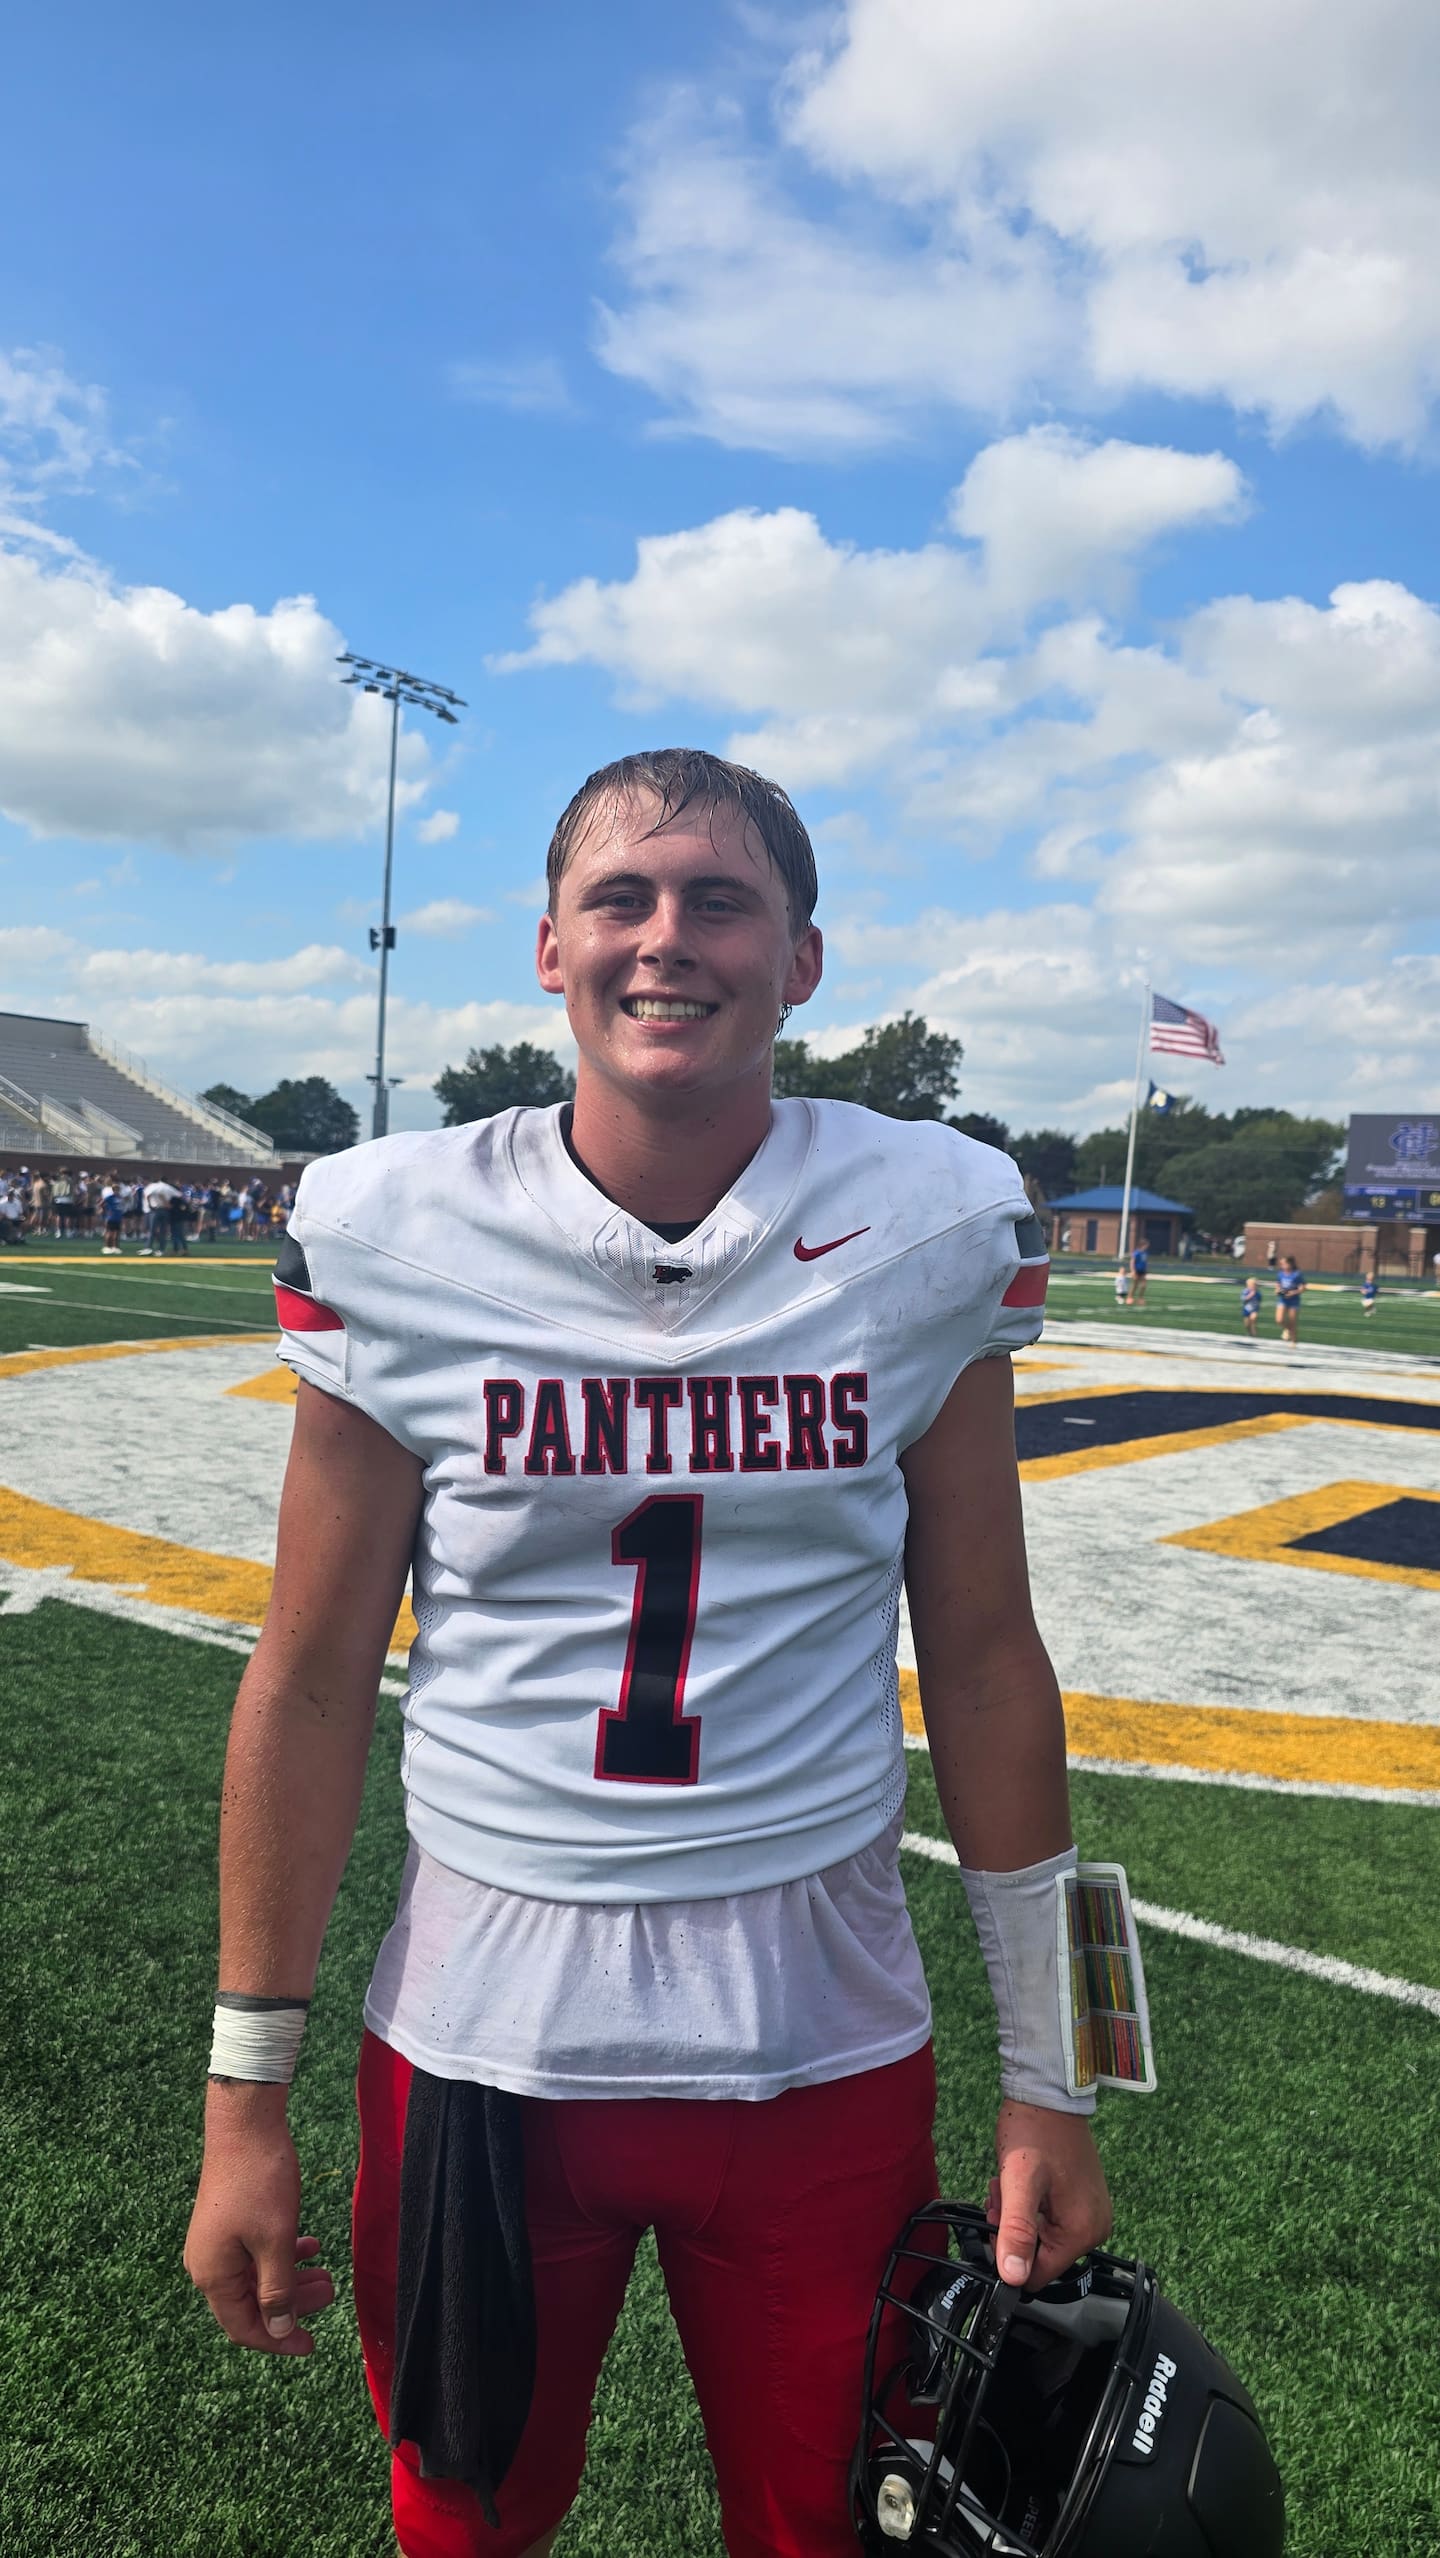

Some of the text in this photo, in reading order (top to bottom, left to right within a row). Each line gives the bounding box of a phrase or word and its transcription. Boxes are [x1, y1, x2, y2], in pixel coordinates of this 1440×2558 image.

[482, 1372, 869, 1476] PANTHERS
[593, 1493, 704, 1786] 1
[1132, 2352, 1177, 2455] Riddell
